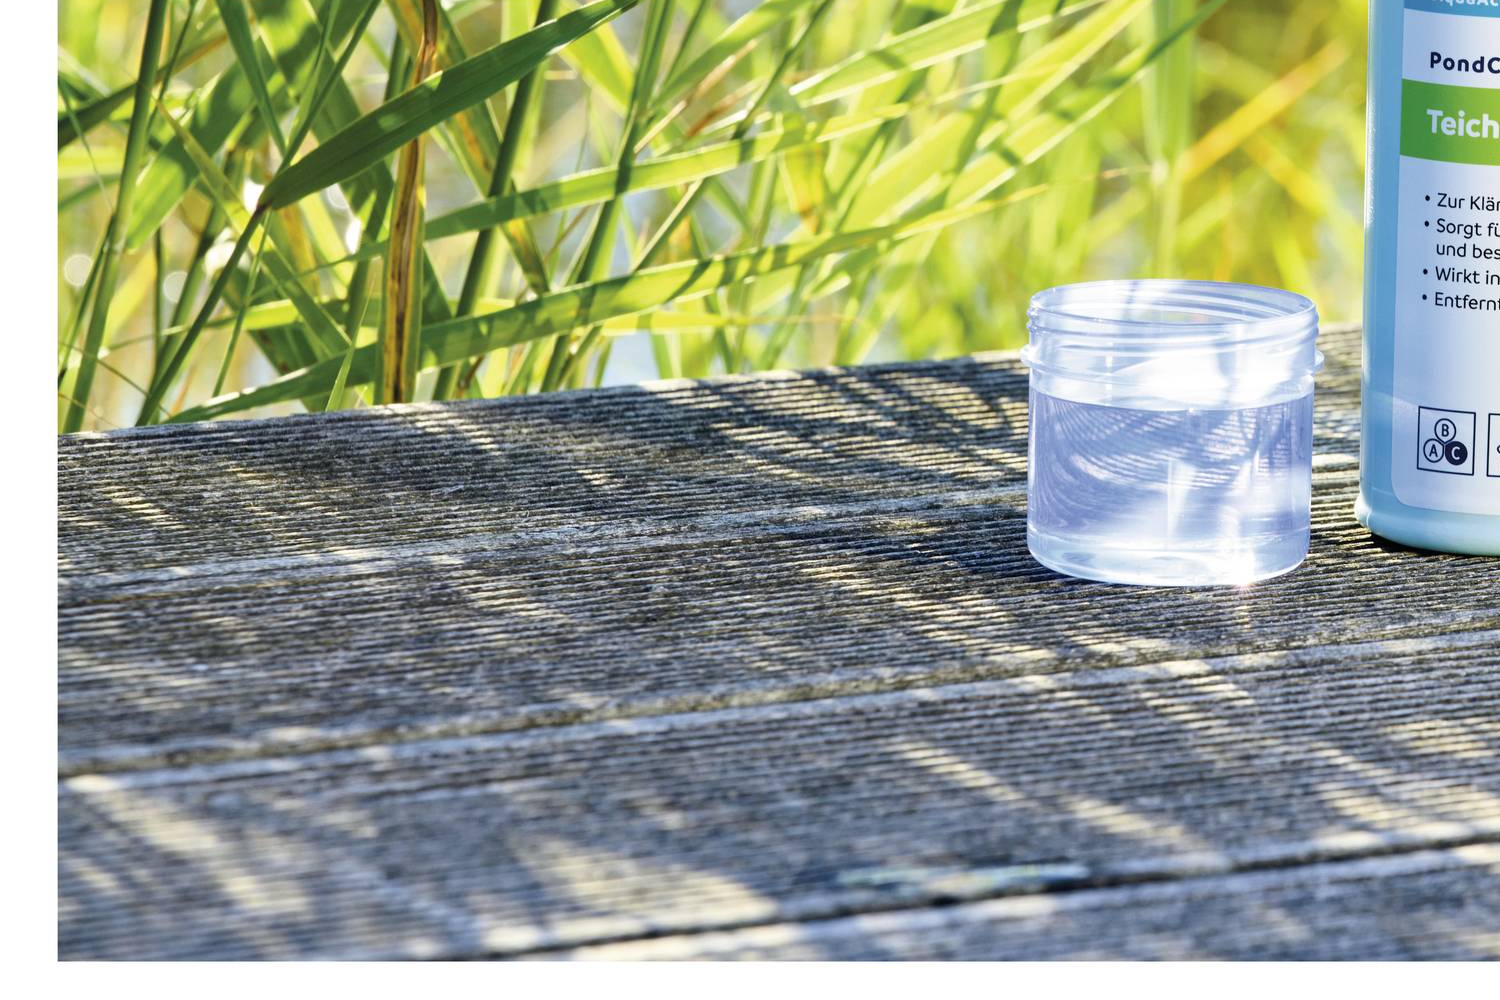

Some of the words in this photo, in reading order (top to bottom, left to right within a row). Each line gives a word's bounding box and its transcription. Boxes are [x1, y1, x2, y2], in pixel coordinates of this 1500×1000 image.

[1436, 192, 1466, 209] Zur
[1436, 217, 1483, 240] Sorgt
[1436, 242, 1467, 258] und
[1435, 265, 1481, 285] Wirkt
[1441, 423, 1449, 437] B
[1428, 445, 1439, 459] A
[1453, 446, 1461, 461] C
